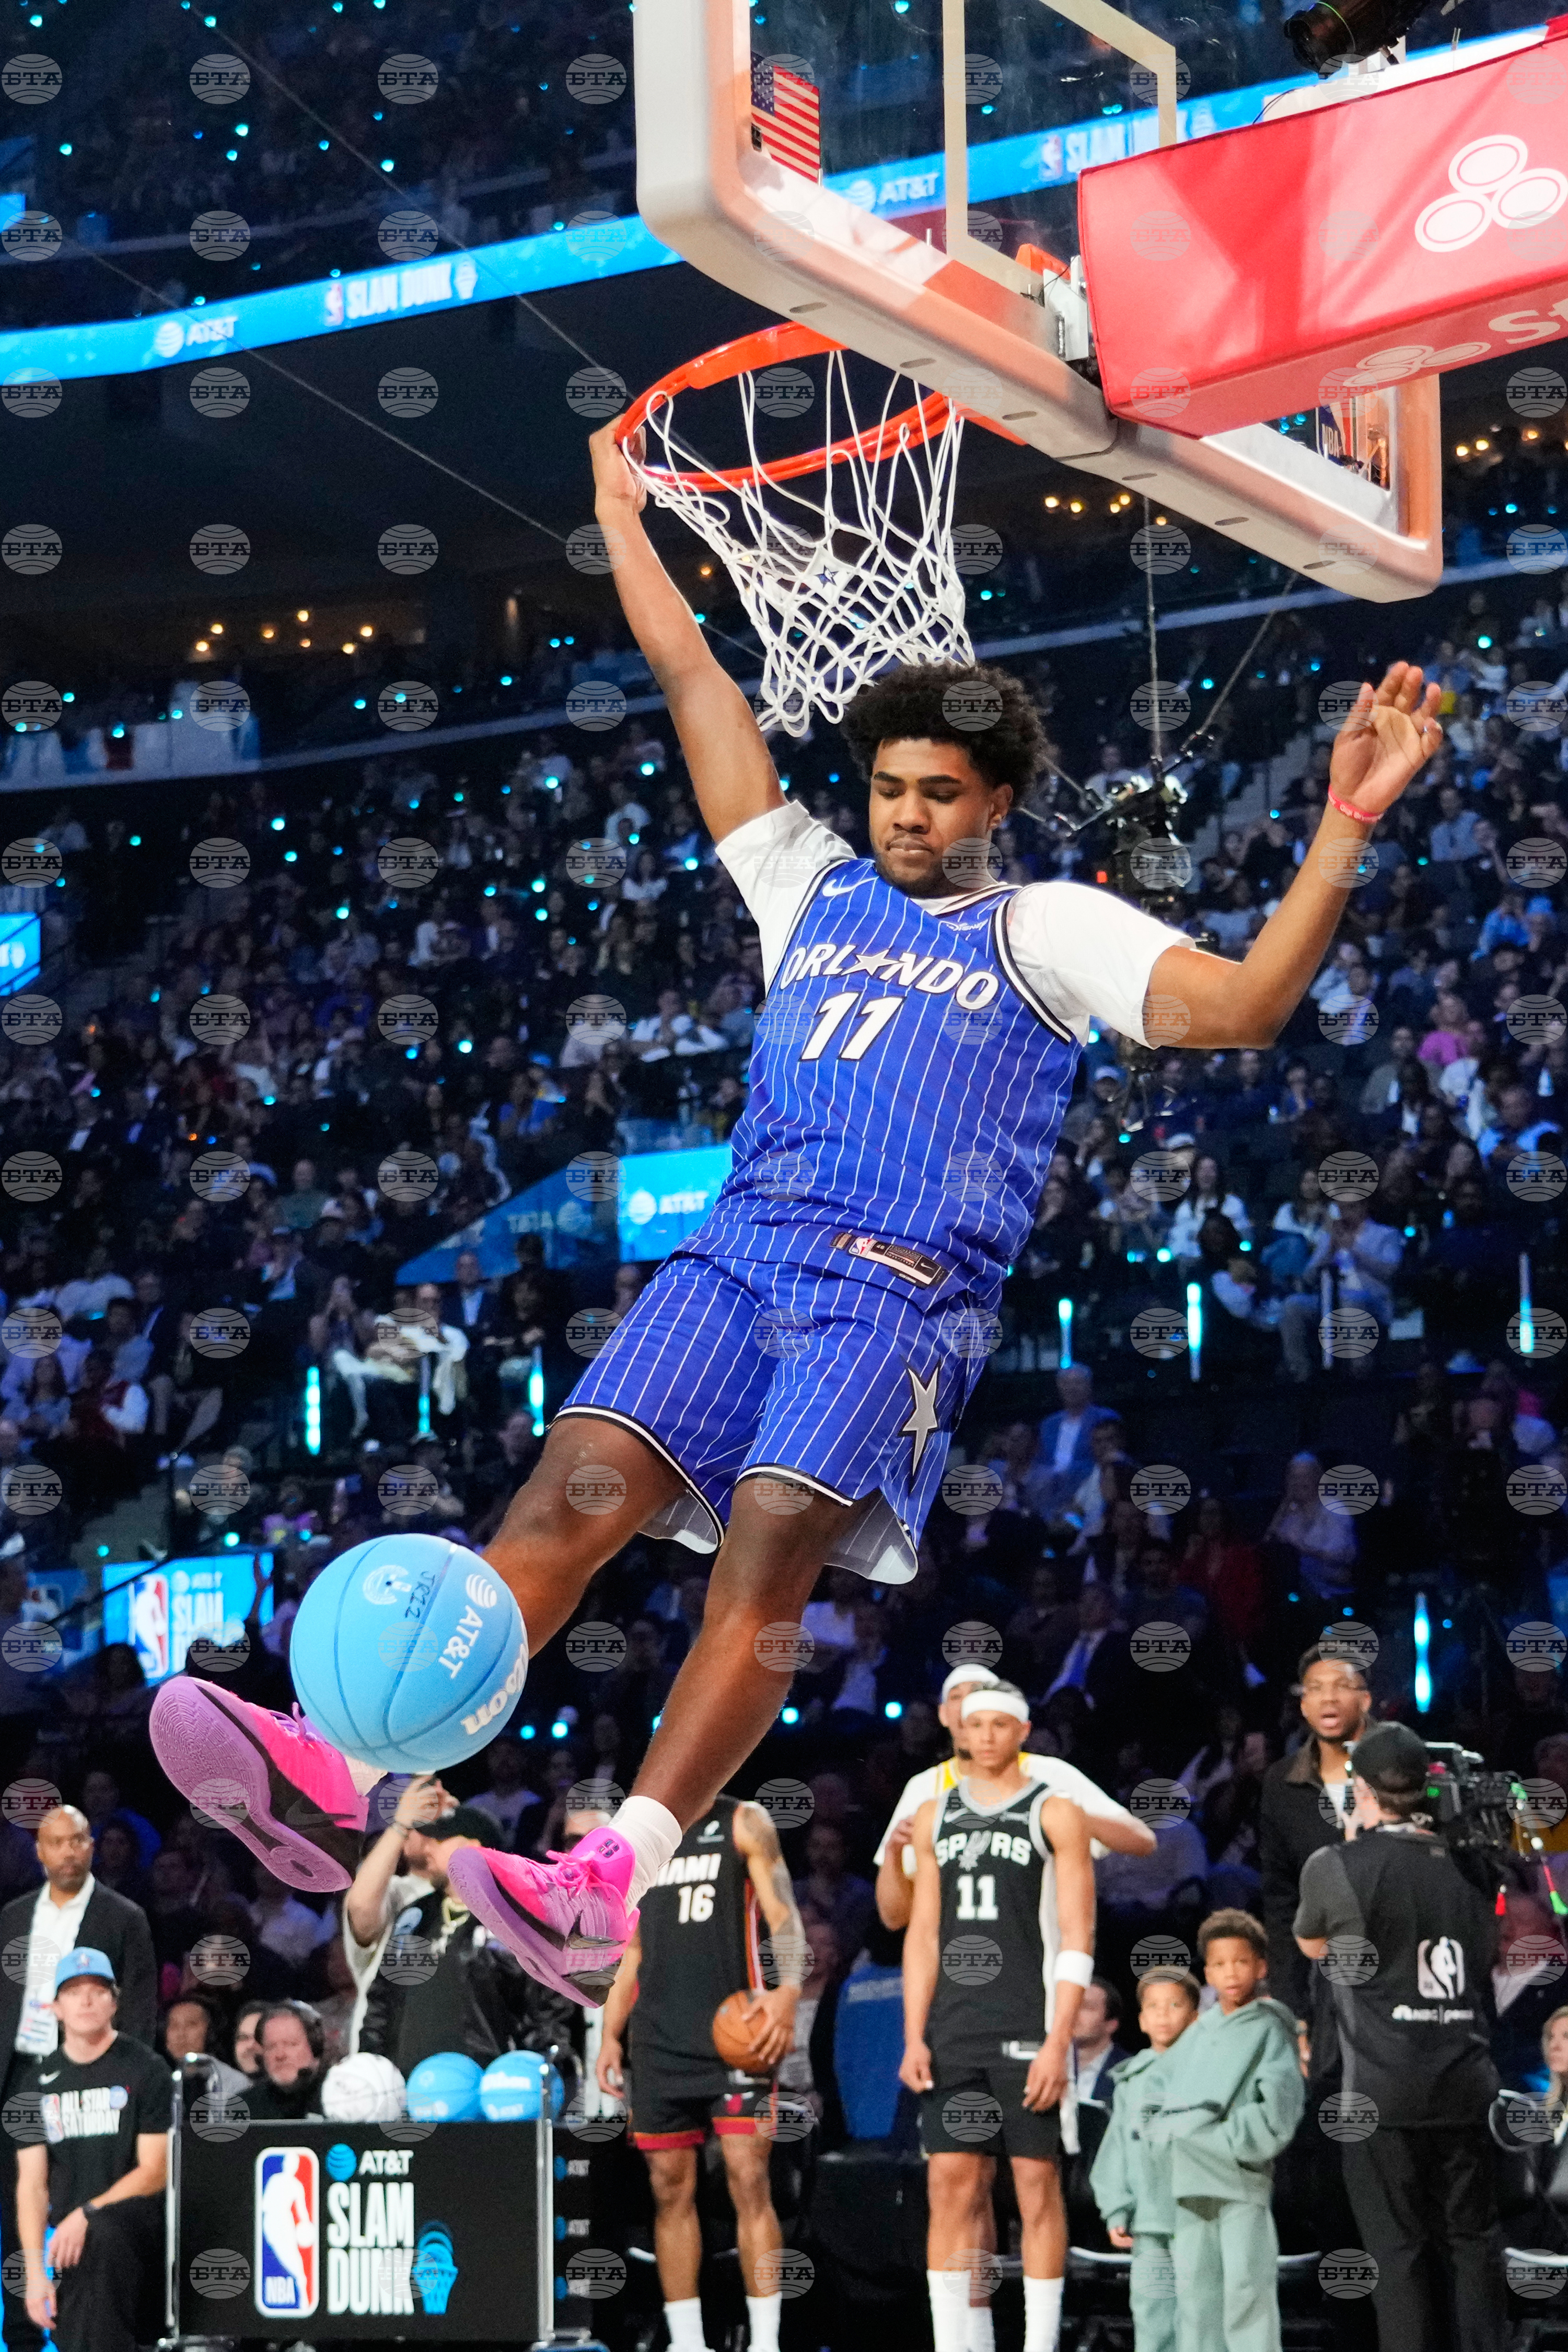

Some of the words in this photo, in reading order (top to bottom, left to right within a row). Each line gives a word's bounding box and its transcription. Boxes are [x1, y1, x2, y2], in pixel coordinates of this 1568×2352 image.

[879, 172, 938, 205] AT&T
[186, 316, 238, 346] AT&T
[798, 992, 908, 1061] 11
[438, 1604, 483, 1679] AT&T
[656, 1852, 722, 1887] IAMI
[678, 1883, 716, 1925] 16
[956, 1873, 999, 1920] 11
[358, 2149, 414, 2175] AT&T
[327, 2181, 415, 2249] SLAM
[266, 2276, 296, 2304] NBA
[327, 2247, 415, 2315] DUNK
